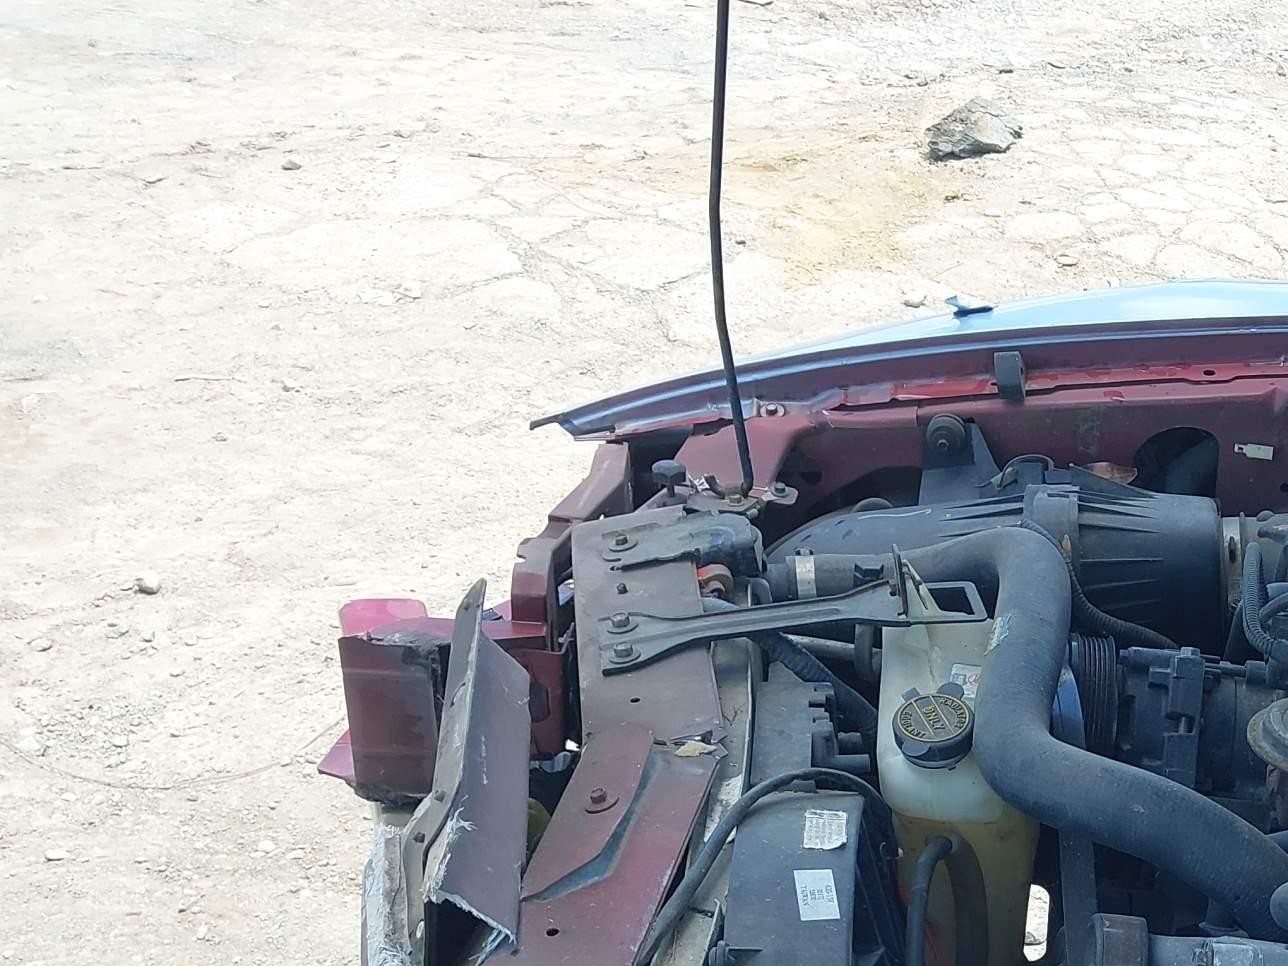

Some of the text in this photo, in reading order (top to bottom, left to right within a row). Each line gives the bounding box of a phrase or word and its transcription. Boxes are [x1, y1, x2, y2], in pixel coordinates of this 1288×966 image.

[901, 710, 927, 738] COOLANT
[922, 704, 946, 730] ONLY
[940, 698, 967, 728] RADIATOR
